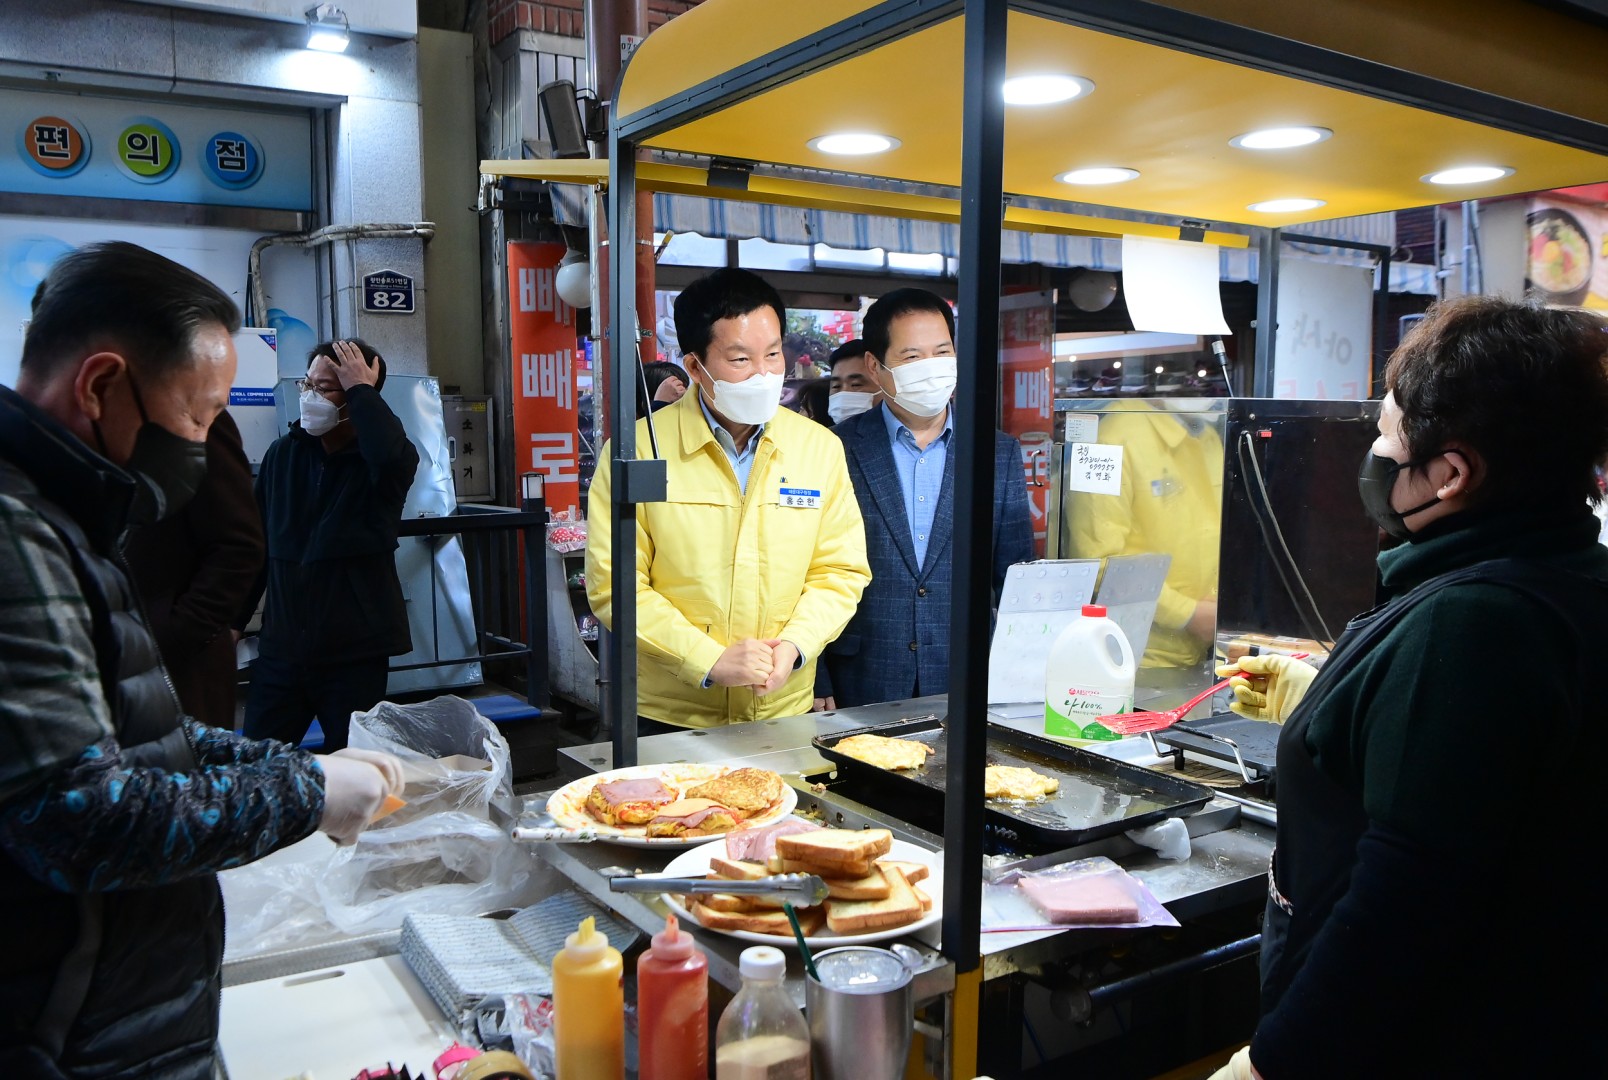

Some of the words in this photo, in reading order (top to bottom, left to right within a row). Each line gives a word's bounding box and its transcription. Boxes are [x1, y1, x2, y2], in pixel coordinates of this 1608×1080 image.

[34, 124, 248, 172] 편의점
[373, 291, 407, 308] 82
[461, 418, 474, 480] 소화기
